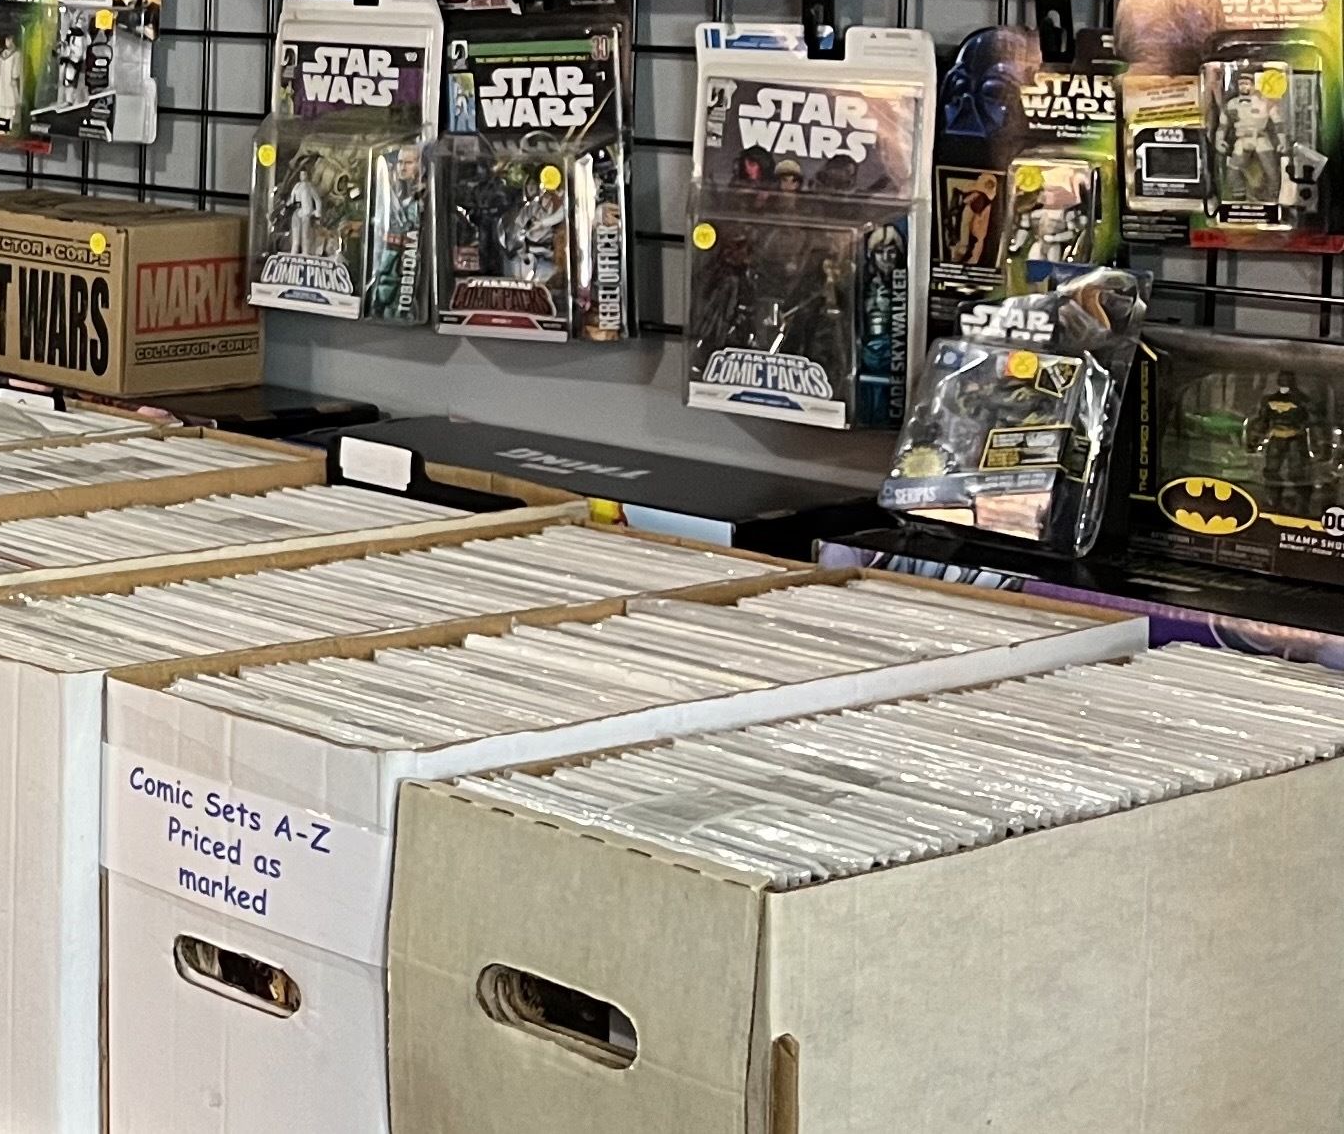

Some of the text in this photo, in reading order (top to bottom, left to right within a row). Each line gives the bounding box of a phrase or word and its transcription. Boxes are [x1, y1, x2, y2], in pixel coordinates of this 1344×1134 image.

[302, 46, 399, 78] STAR
[302, 73, 399, 107] WARS
[479, 66, 594, 97] STAR
[1021, 71, 1116, 96] STAR
[479, 96, 594, 127] WARS
[738, 88, 878, 130] STAR
[738, 118, 877, 163] WARS
[54, 244, 111, 267] CORPS
[402, 230, 419, 266] DALA
[264, 265, 353, 294] COMIC PACKS
[597, 225, 620, 330] REBEL OFFICER
[18, 266, 110, 377] WARS
[960, 304, 1055, 332] STAR
[135, 342, 210, 360] COLLECTOR
[889, 268, 907, 419] CADE SKYWALKER
[711, 354, 832, 400] COMIC PACKS
[1279, 533, 1318, 546] SWAMP
[129, 767, 332, 854] Comic Sets A-Z
[167, 816, 282, 879] Priced as
[178, 867, 268, 916] marked
